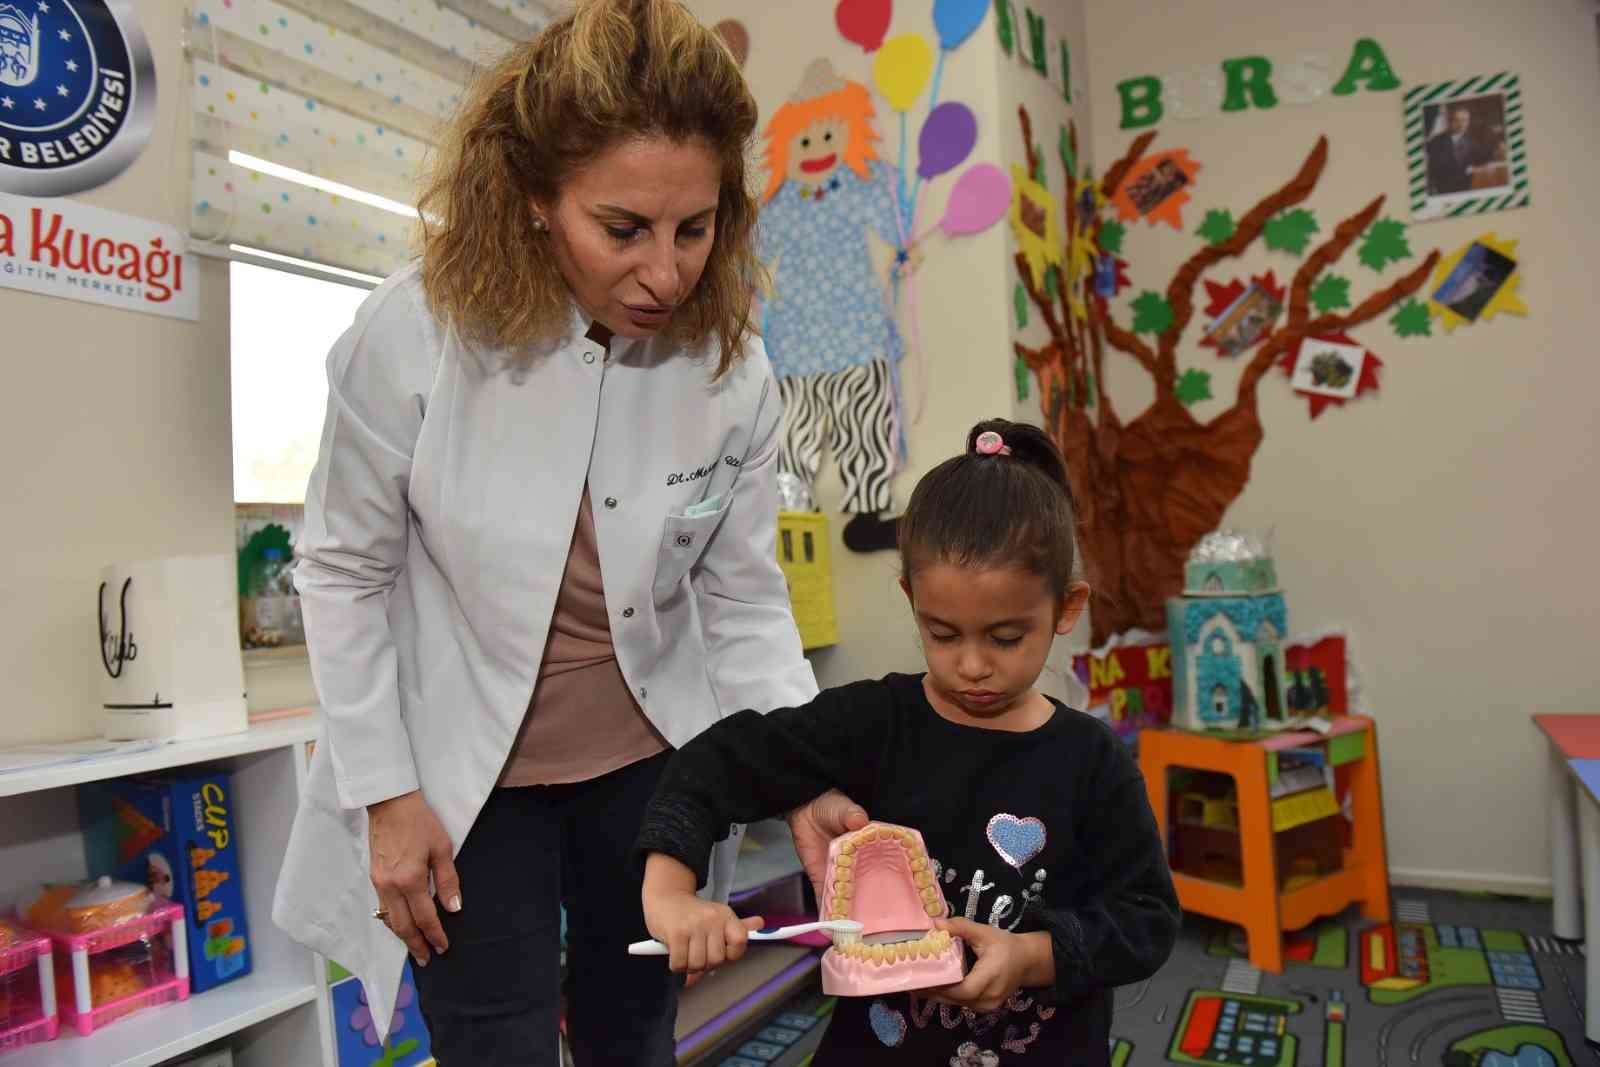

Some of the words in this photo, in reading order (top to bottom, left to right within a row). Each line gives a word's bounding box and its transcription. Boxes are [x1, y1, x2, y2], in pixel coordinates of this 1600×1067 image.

[20, 68, 126, 164] BELEDİYESİ
[31, 208, 182, 302] Kucağı
[202, 784, 229, 849] CUP
